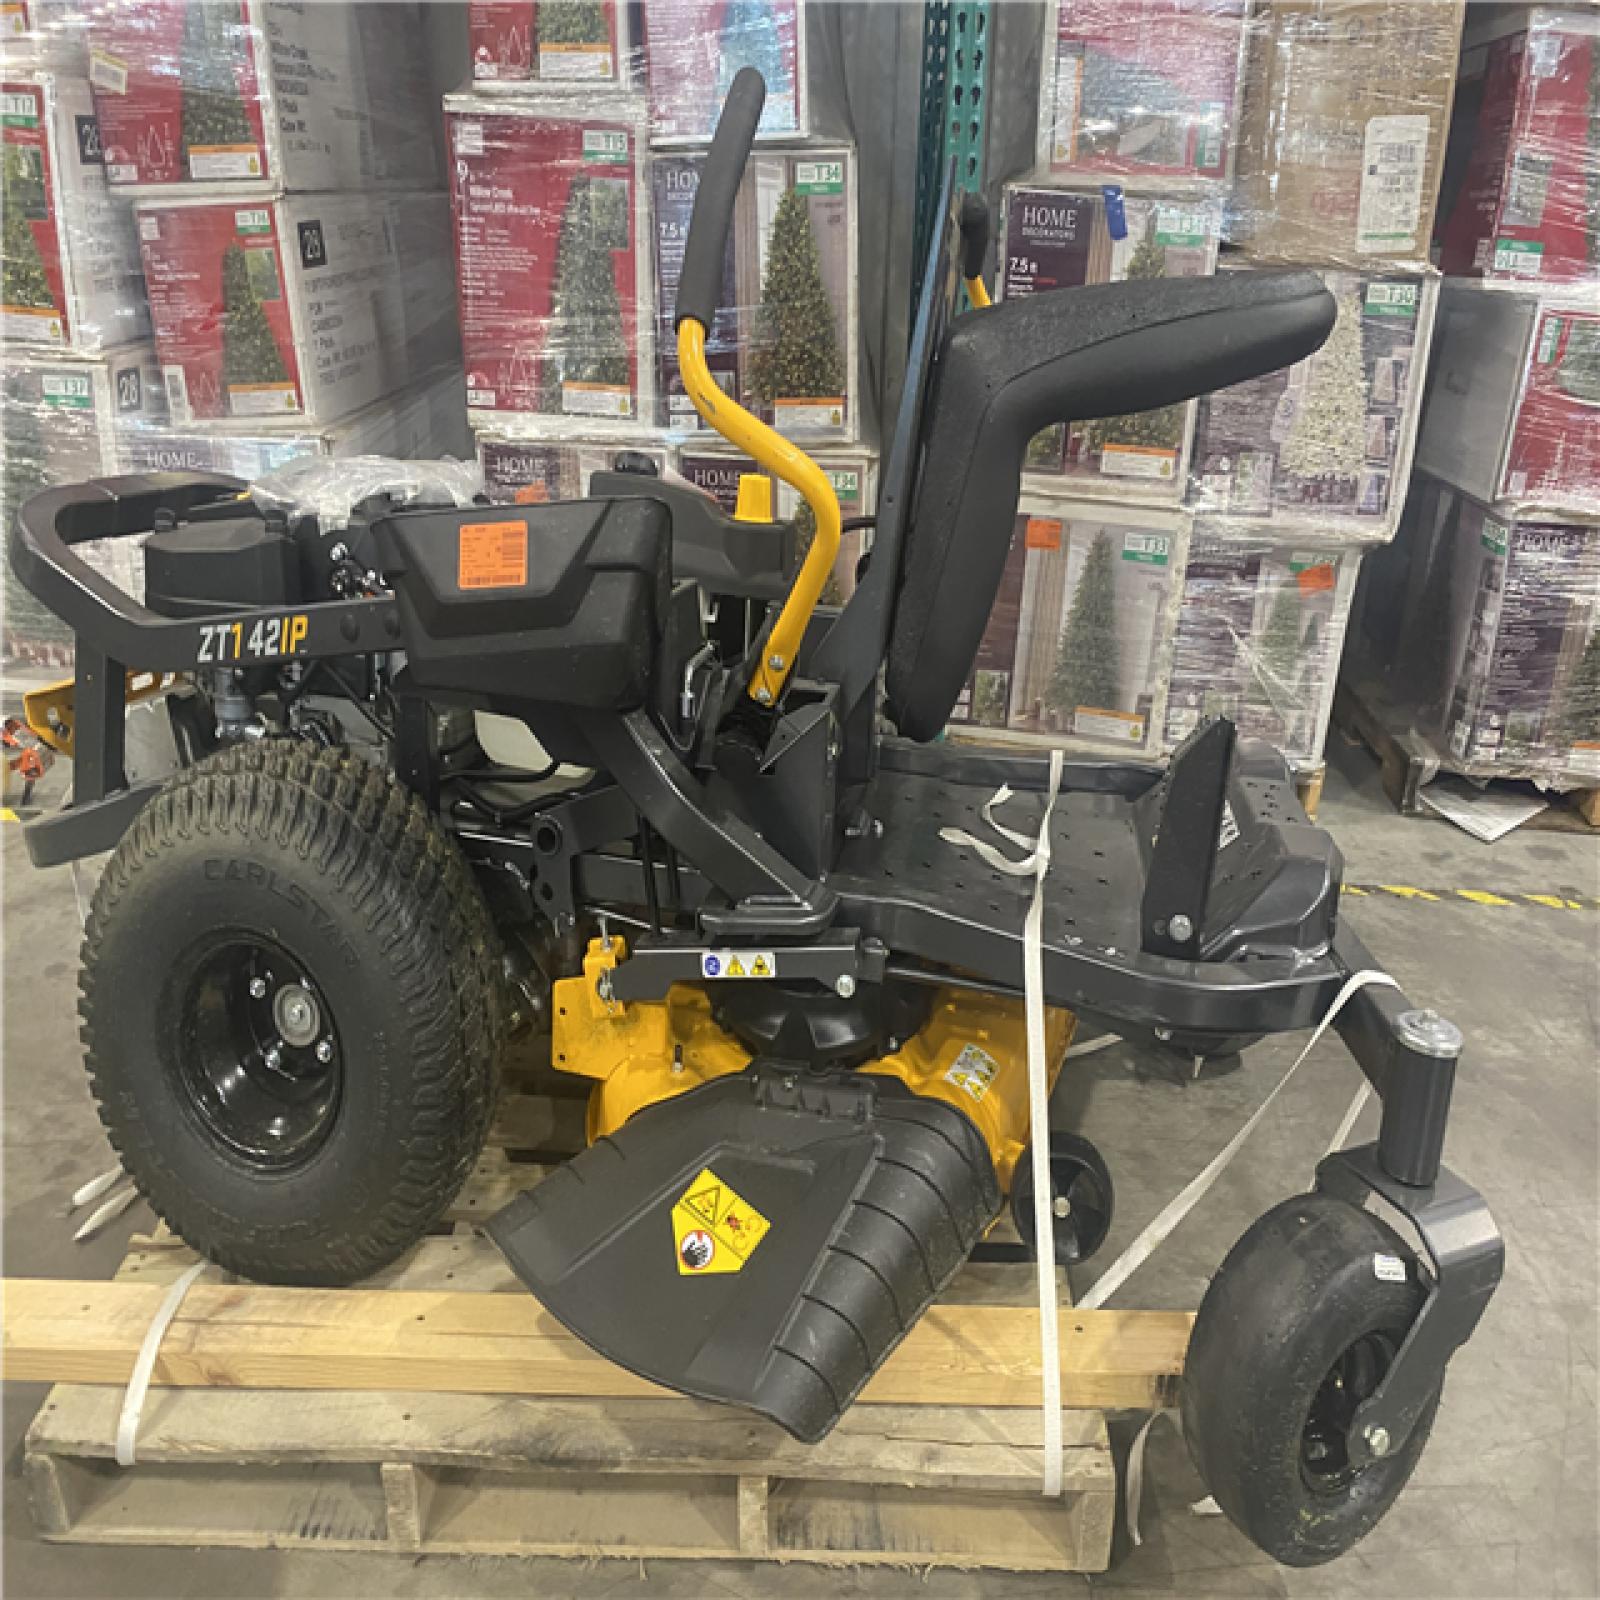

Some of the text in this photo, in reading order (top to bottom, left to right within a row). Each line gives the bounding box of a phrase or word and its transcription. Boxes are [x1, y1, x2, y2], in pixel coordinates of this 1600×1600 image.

[1022, 204, 1079, 229] HOME
[147, 450, 198, 468] HOME
[496, 456, 546, 474] HOME
[196, 621, 244, 664] ZT1
